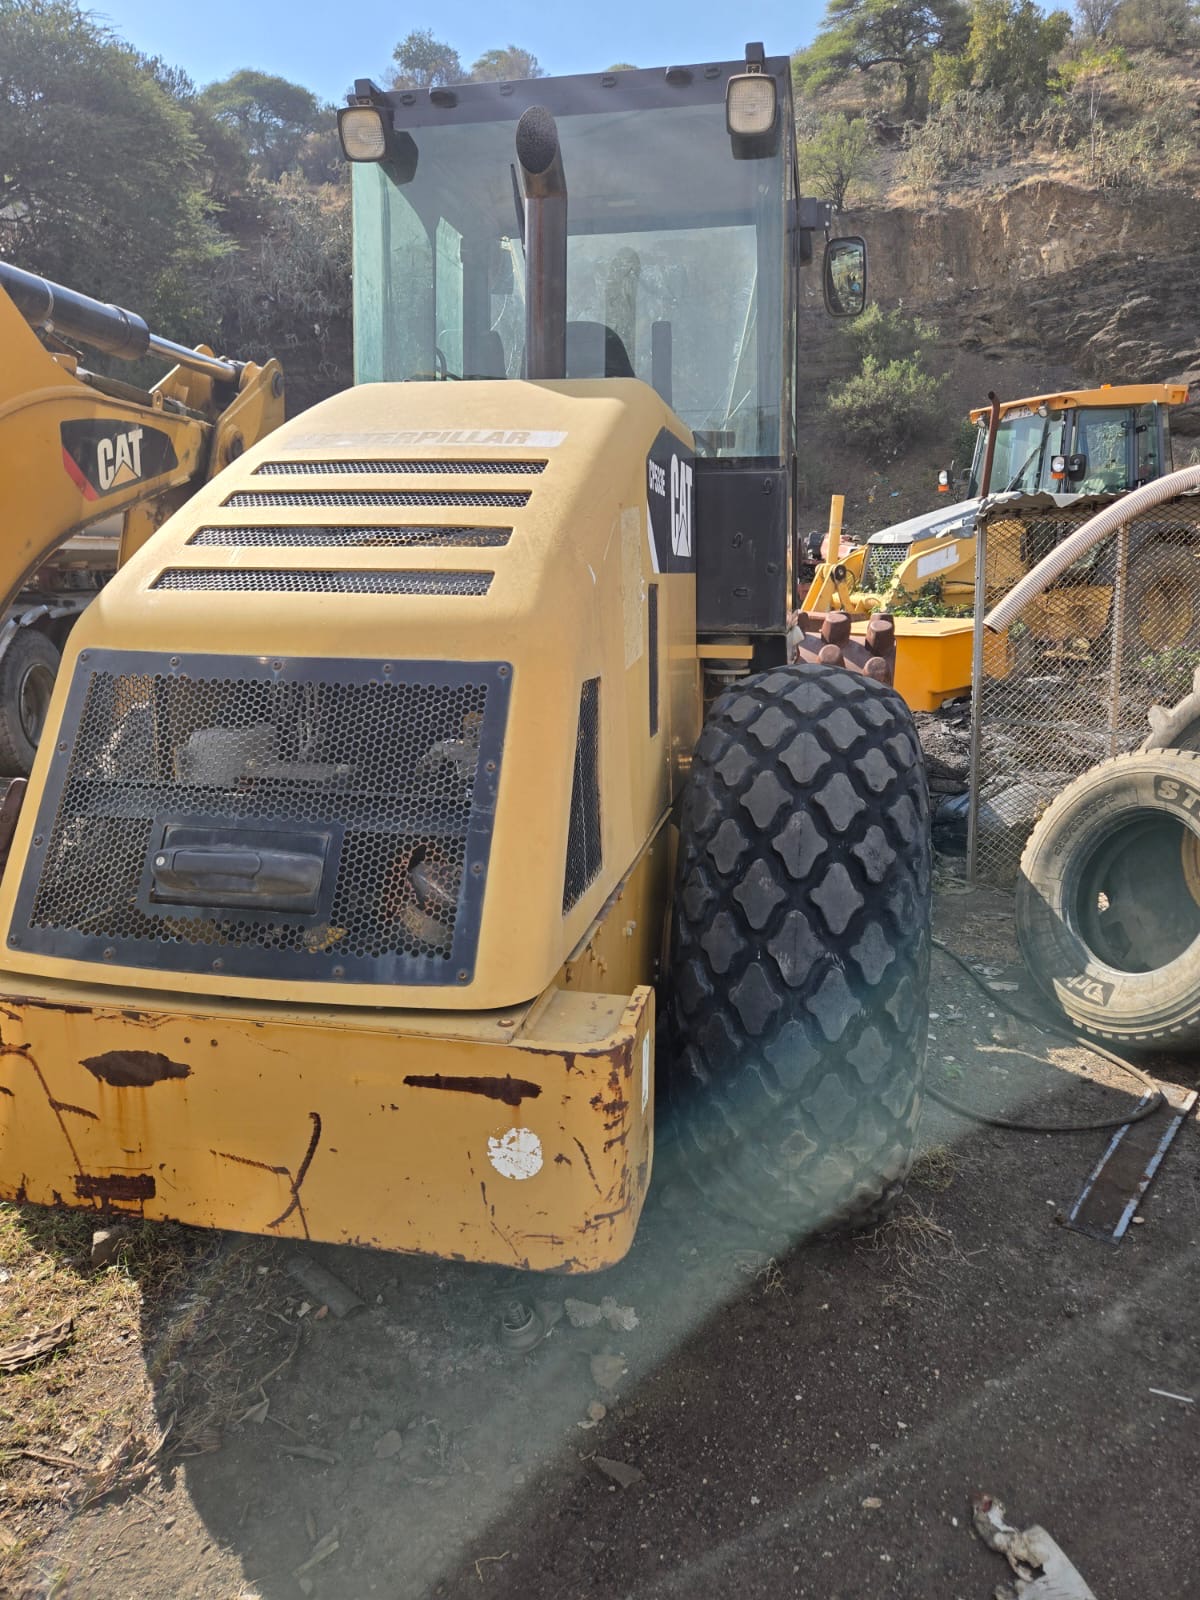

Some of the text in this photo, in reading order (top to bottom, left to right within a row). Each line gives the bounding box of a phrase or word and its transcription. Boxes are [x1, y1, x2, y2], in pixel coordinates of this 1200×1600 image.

[97, 429, 143, 490] CAT
[671, 453, 693, 558] CAT
[1158, 780, 1200, 819] ST
